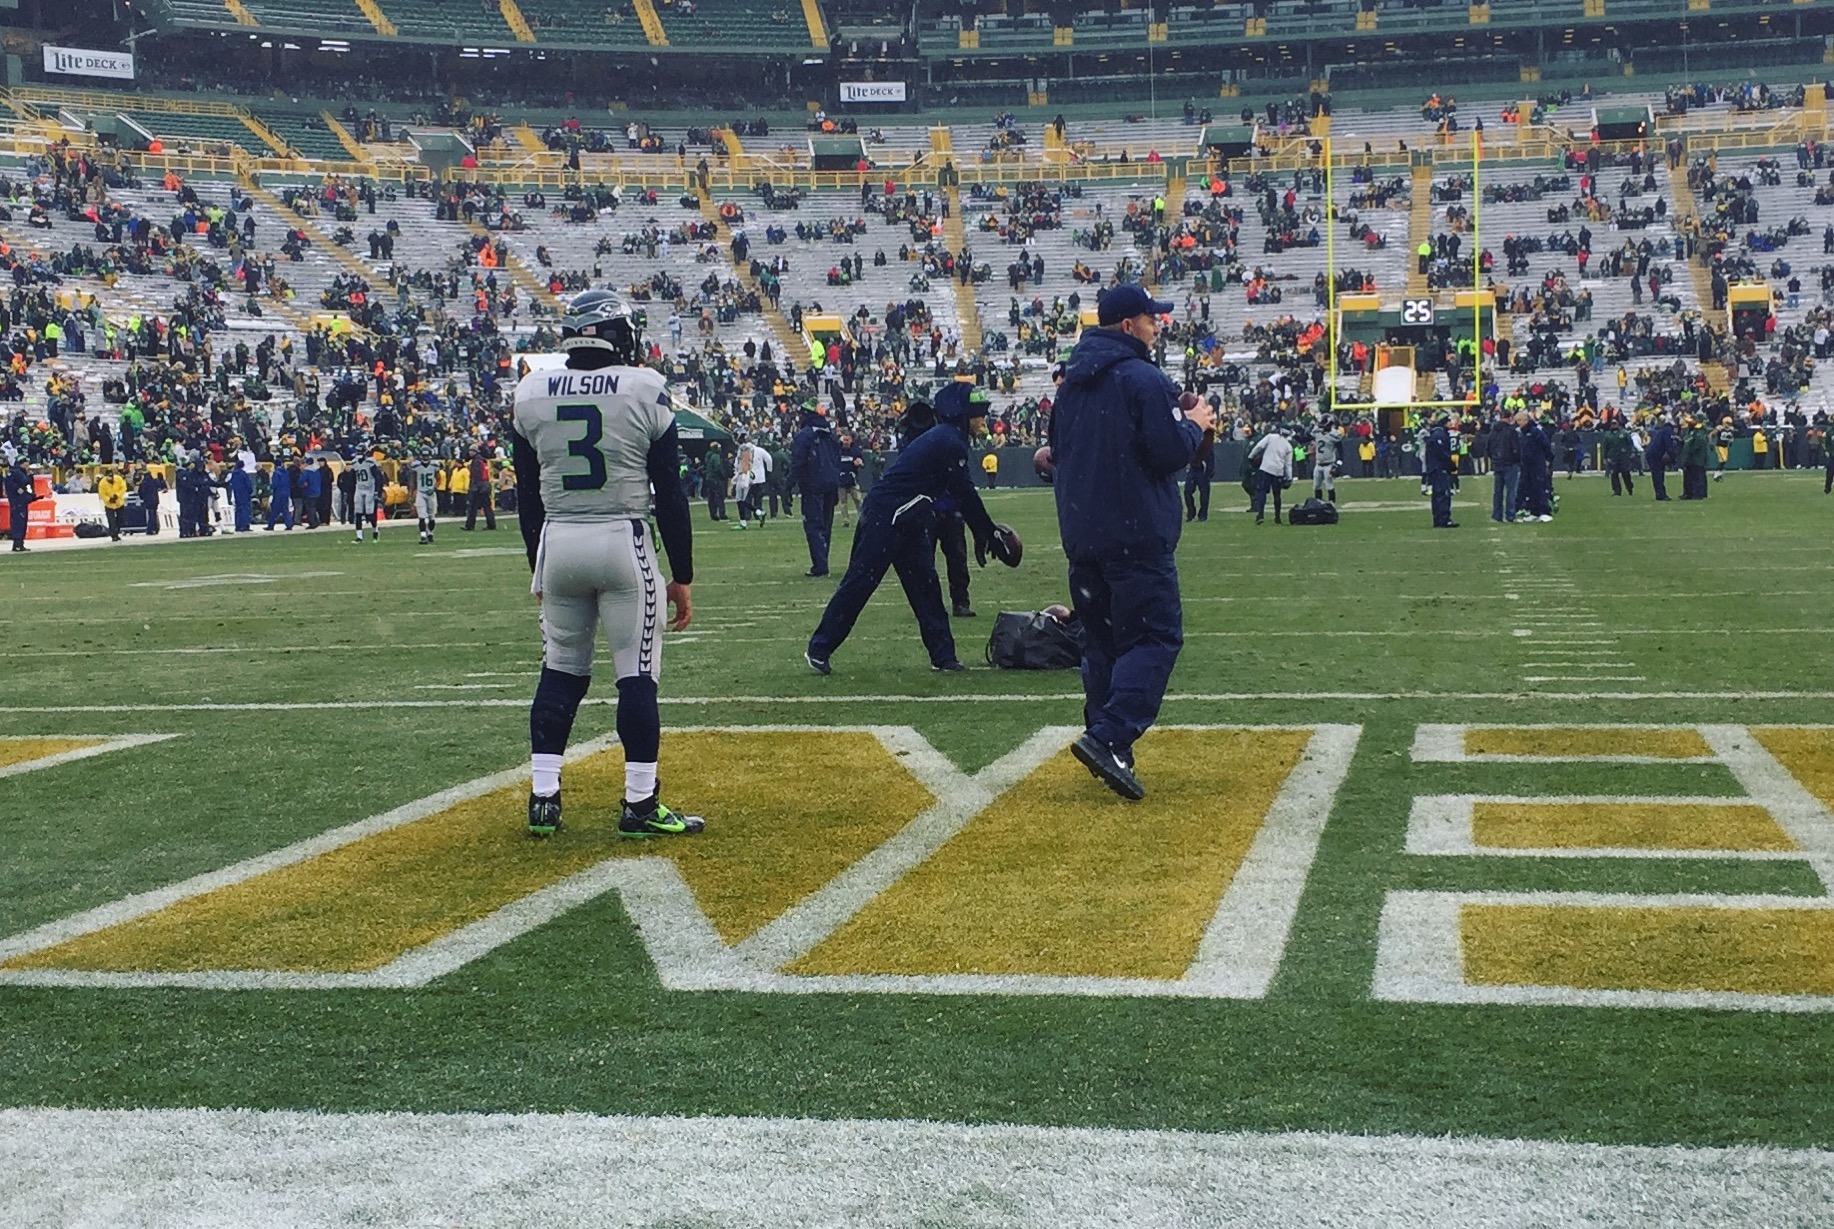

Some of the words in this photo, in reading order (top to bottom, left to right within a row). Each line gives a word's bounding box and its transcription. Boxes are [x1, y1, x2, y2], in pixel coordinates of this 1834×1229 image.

[54, 52, 83, 72] Lite
[86, 58, 118, 70] DECK
[870, 88, 894, 96] DECK
[1404, 300, 1430, 322] 25
[548, 375, 620, 396] WILSON
[556, 403, 609, 491] 3
[420, 472, 434, 488] 16
